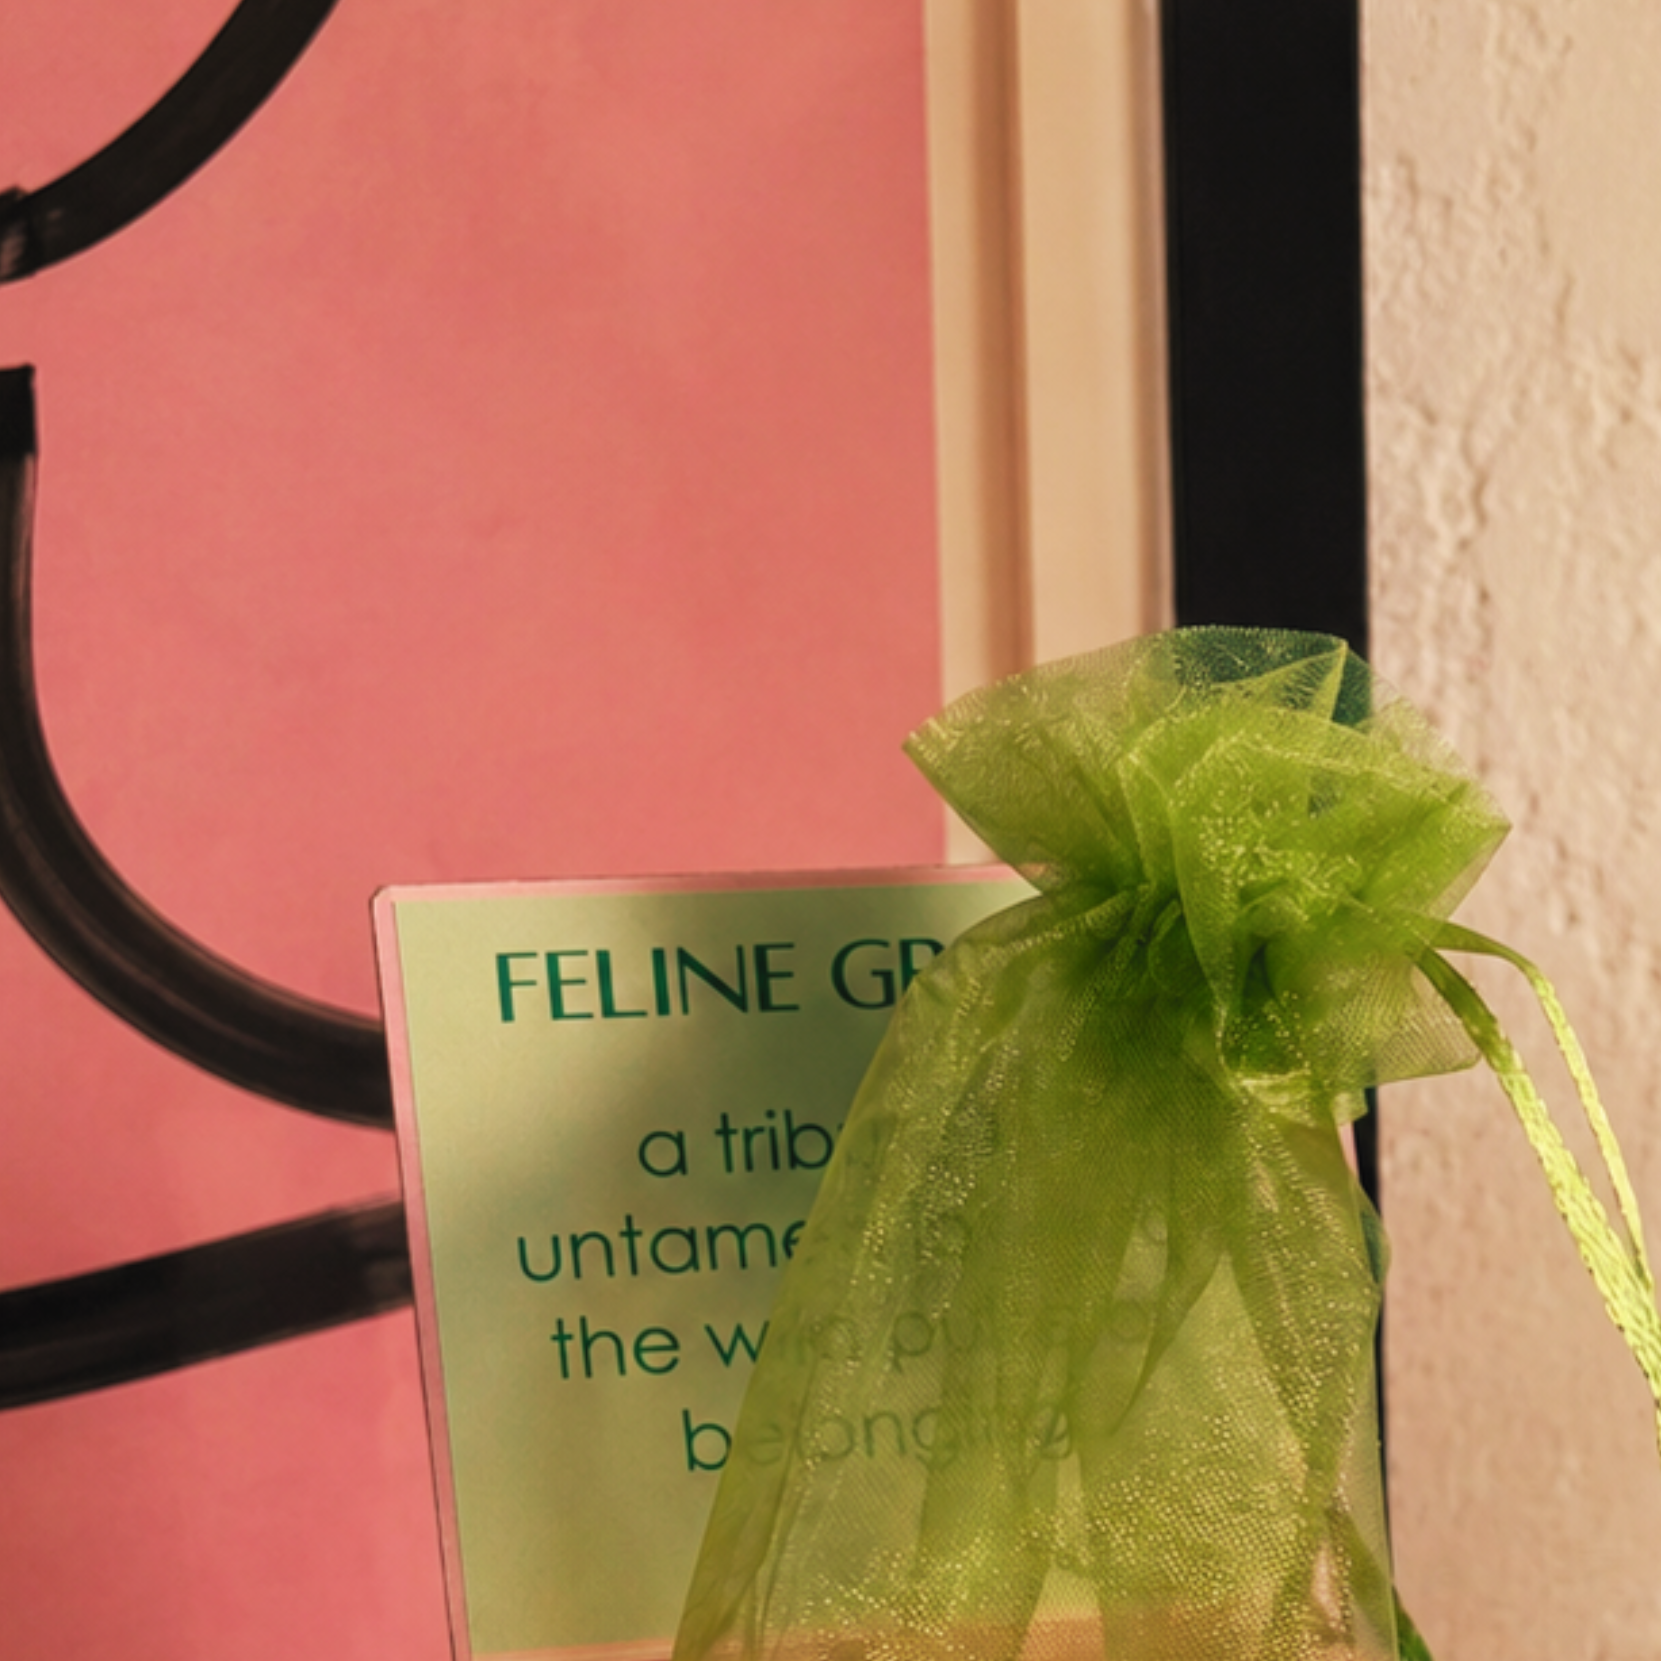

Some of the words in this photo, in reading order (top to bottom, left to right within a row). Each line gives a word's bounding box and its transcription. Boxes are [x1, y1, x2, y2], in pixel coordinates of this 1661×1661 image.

[496, 940, 800, 1022] FELINE
[639, 1129, 687, 1177] a
[518, 1211, 808, 1284] untame
[551, 1314, 679, 1380] the
